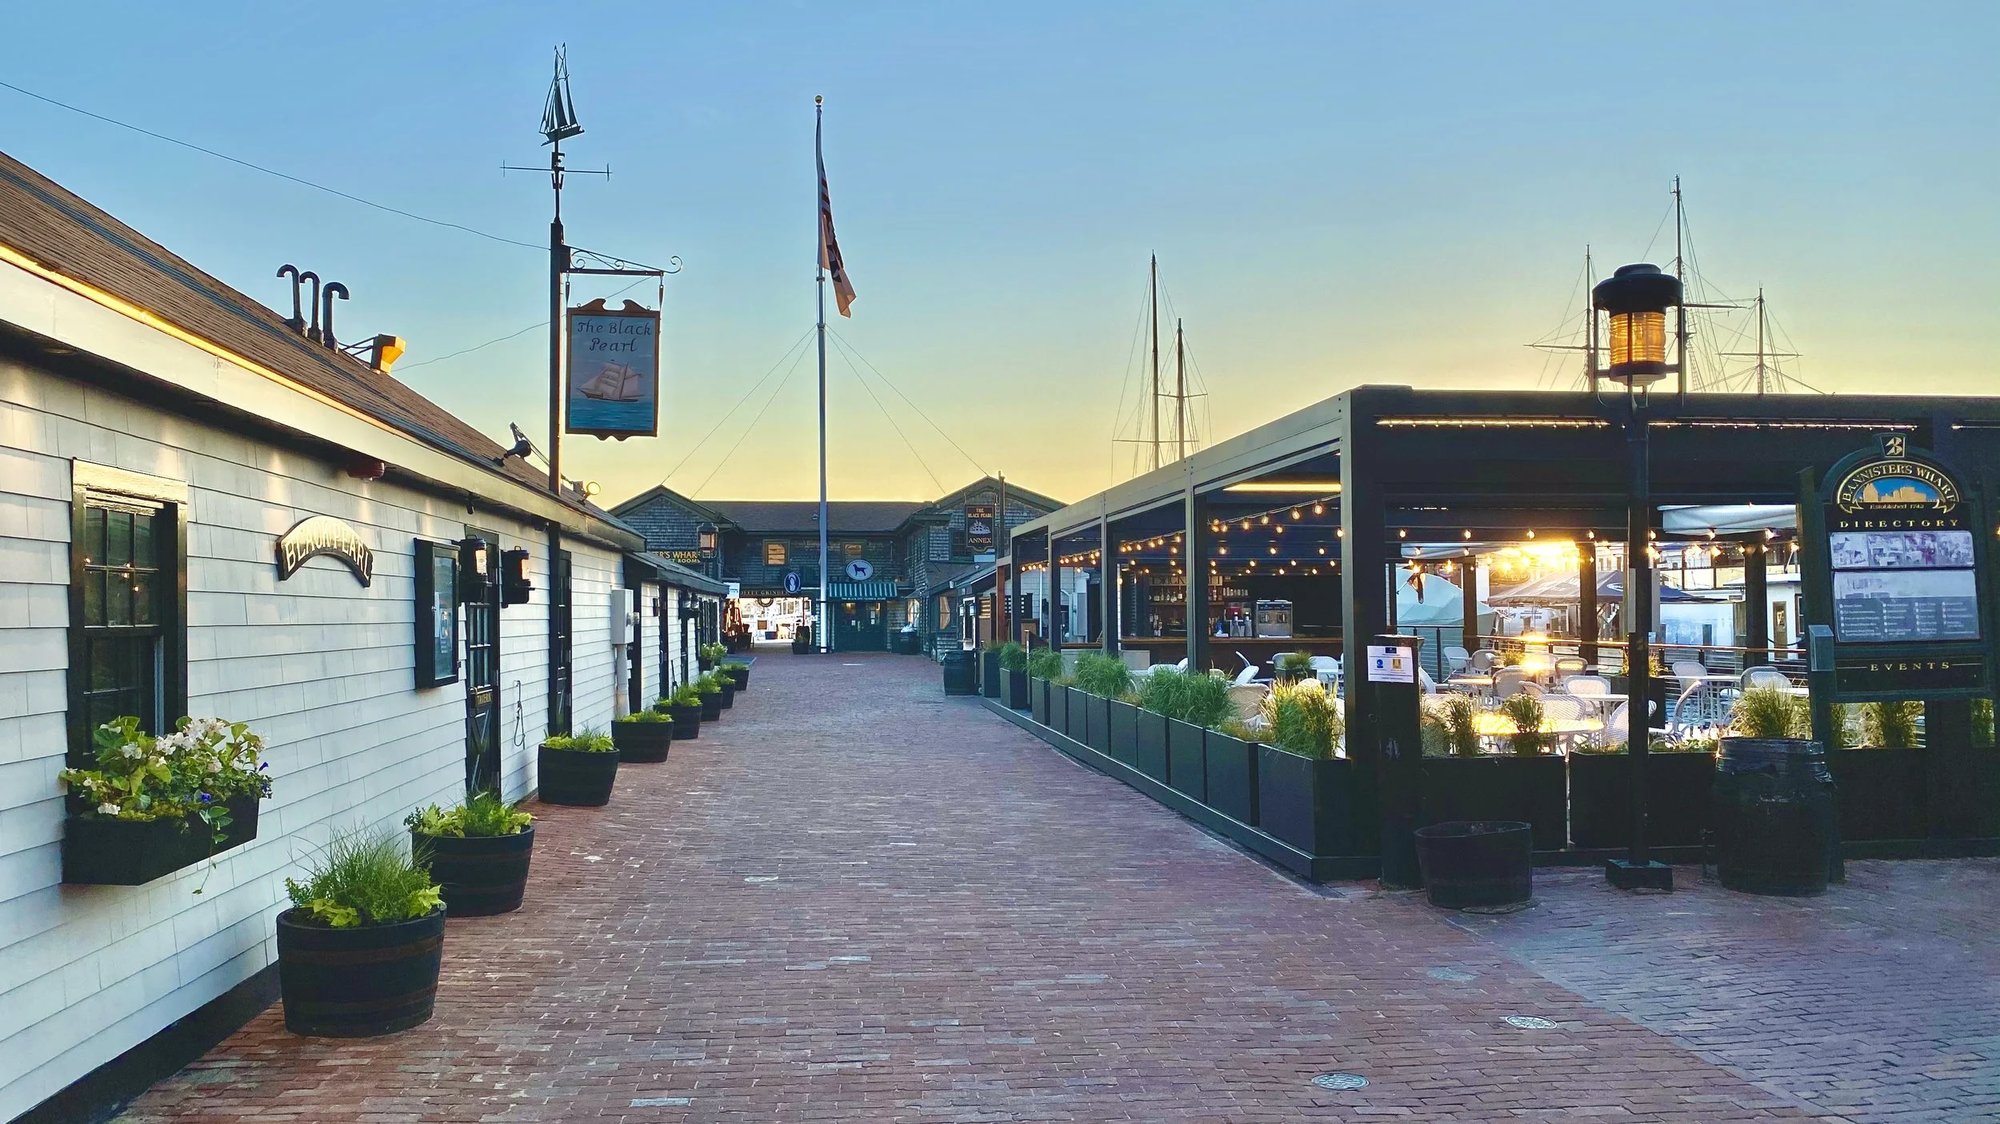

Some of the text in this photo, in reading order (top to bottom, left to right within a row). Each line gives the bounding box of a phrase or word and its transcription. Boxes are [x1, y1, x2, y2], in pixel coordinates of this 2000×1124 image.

[577, 319, 653, 336] The Black
[589, 337, 638, 352] Pearl
[1915, 466, 1957, 504] WHARF
[1839, 519, 1959, 528] DIRECTORY
[284, 524, 370, 581] BLACK PEARL
[1870, 661, 1950, 672] EVENTS
